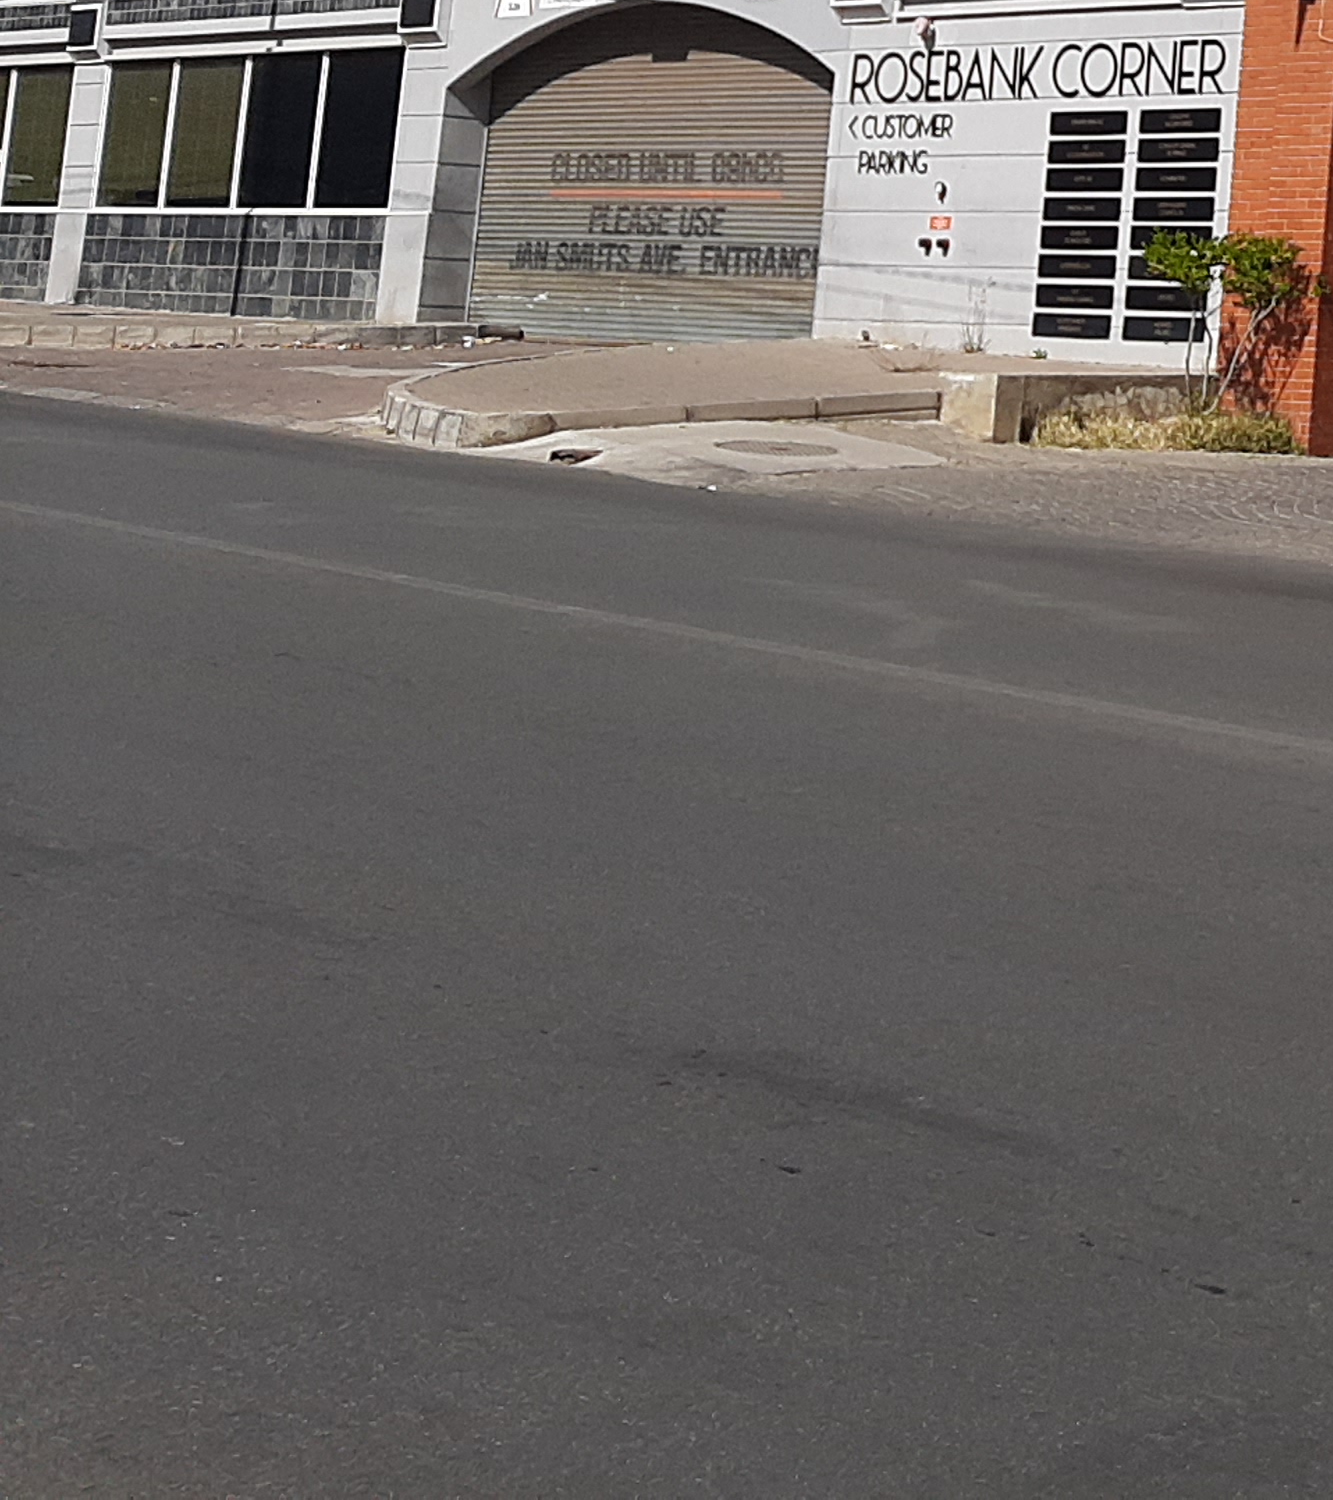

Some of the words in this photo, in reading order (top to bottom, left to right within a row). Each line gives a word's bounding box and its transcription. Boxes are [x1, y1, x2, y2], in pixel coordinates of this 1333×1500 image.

[850, 44, 1045, 105] ROSEBANK
[1053, 38, 1227, 99] CORNER
[861, 113, 953, 140] CUSTOMER
[551, 151, 629, 182] CLOSED
[638, 151, 702, 182] UNTIL
[858, 150, 929, 175] PARKING
[588, 204, 670, 235] PLEASE
[678, 205, 727, 237] USE
[509, 241, 549, 269] JAN
[556, 241, 630, 271] SMUTS
